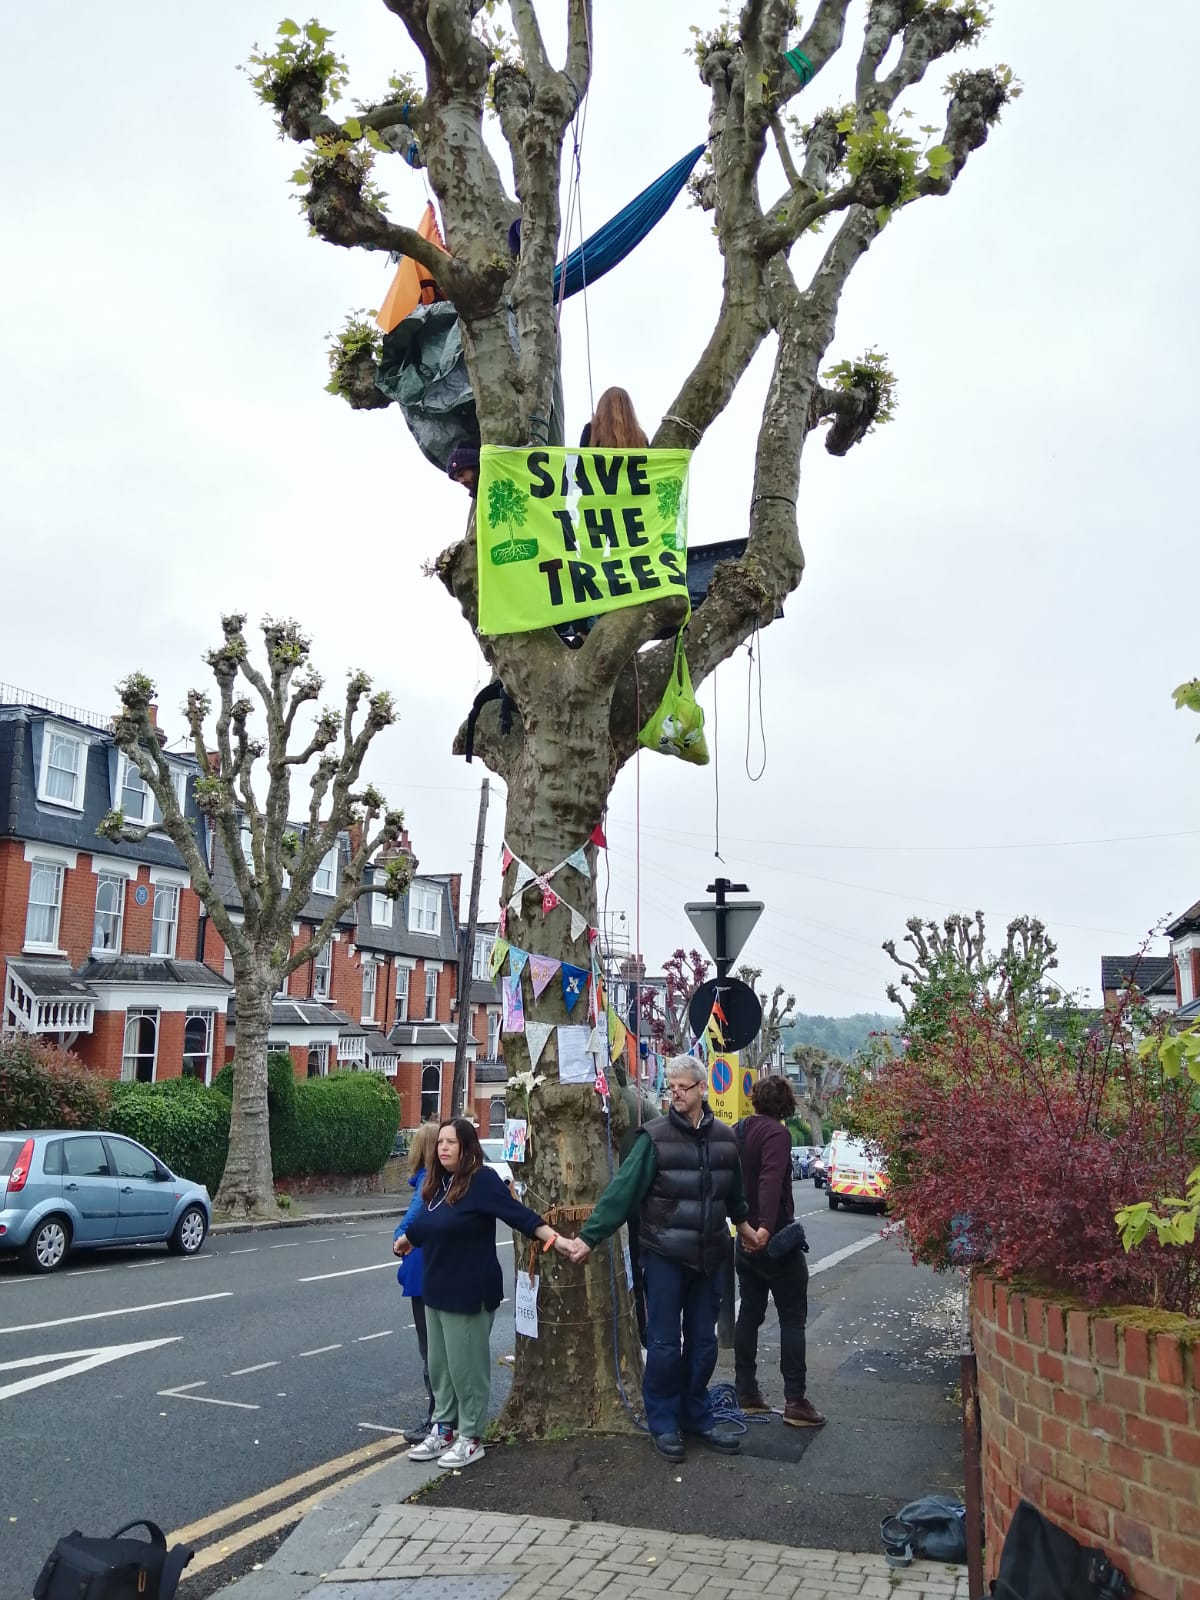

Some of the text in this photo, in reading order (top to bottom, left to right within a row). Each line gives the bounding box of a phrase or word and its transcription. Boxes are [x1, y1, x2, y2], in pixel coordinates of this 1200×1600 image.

[527, 452, 650, 498] SAVE
[552, 508, 649, 552] THE
[539, 551, 686, 606] TREES
